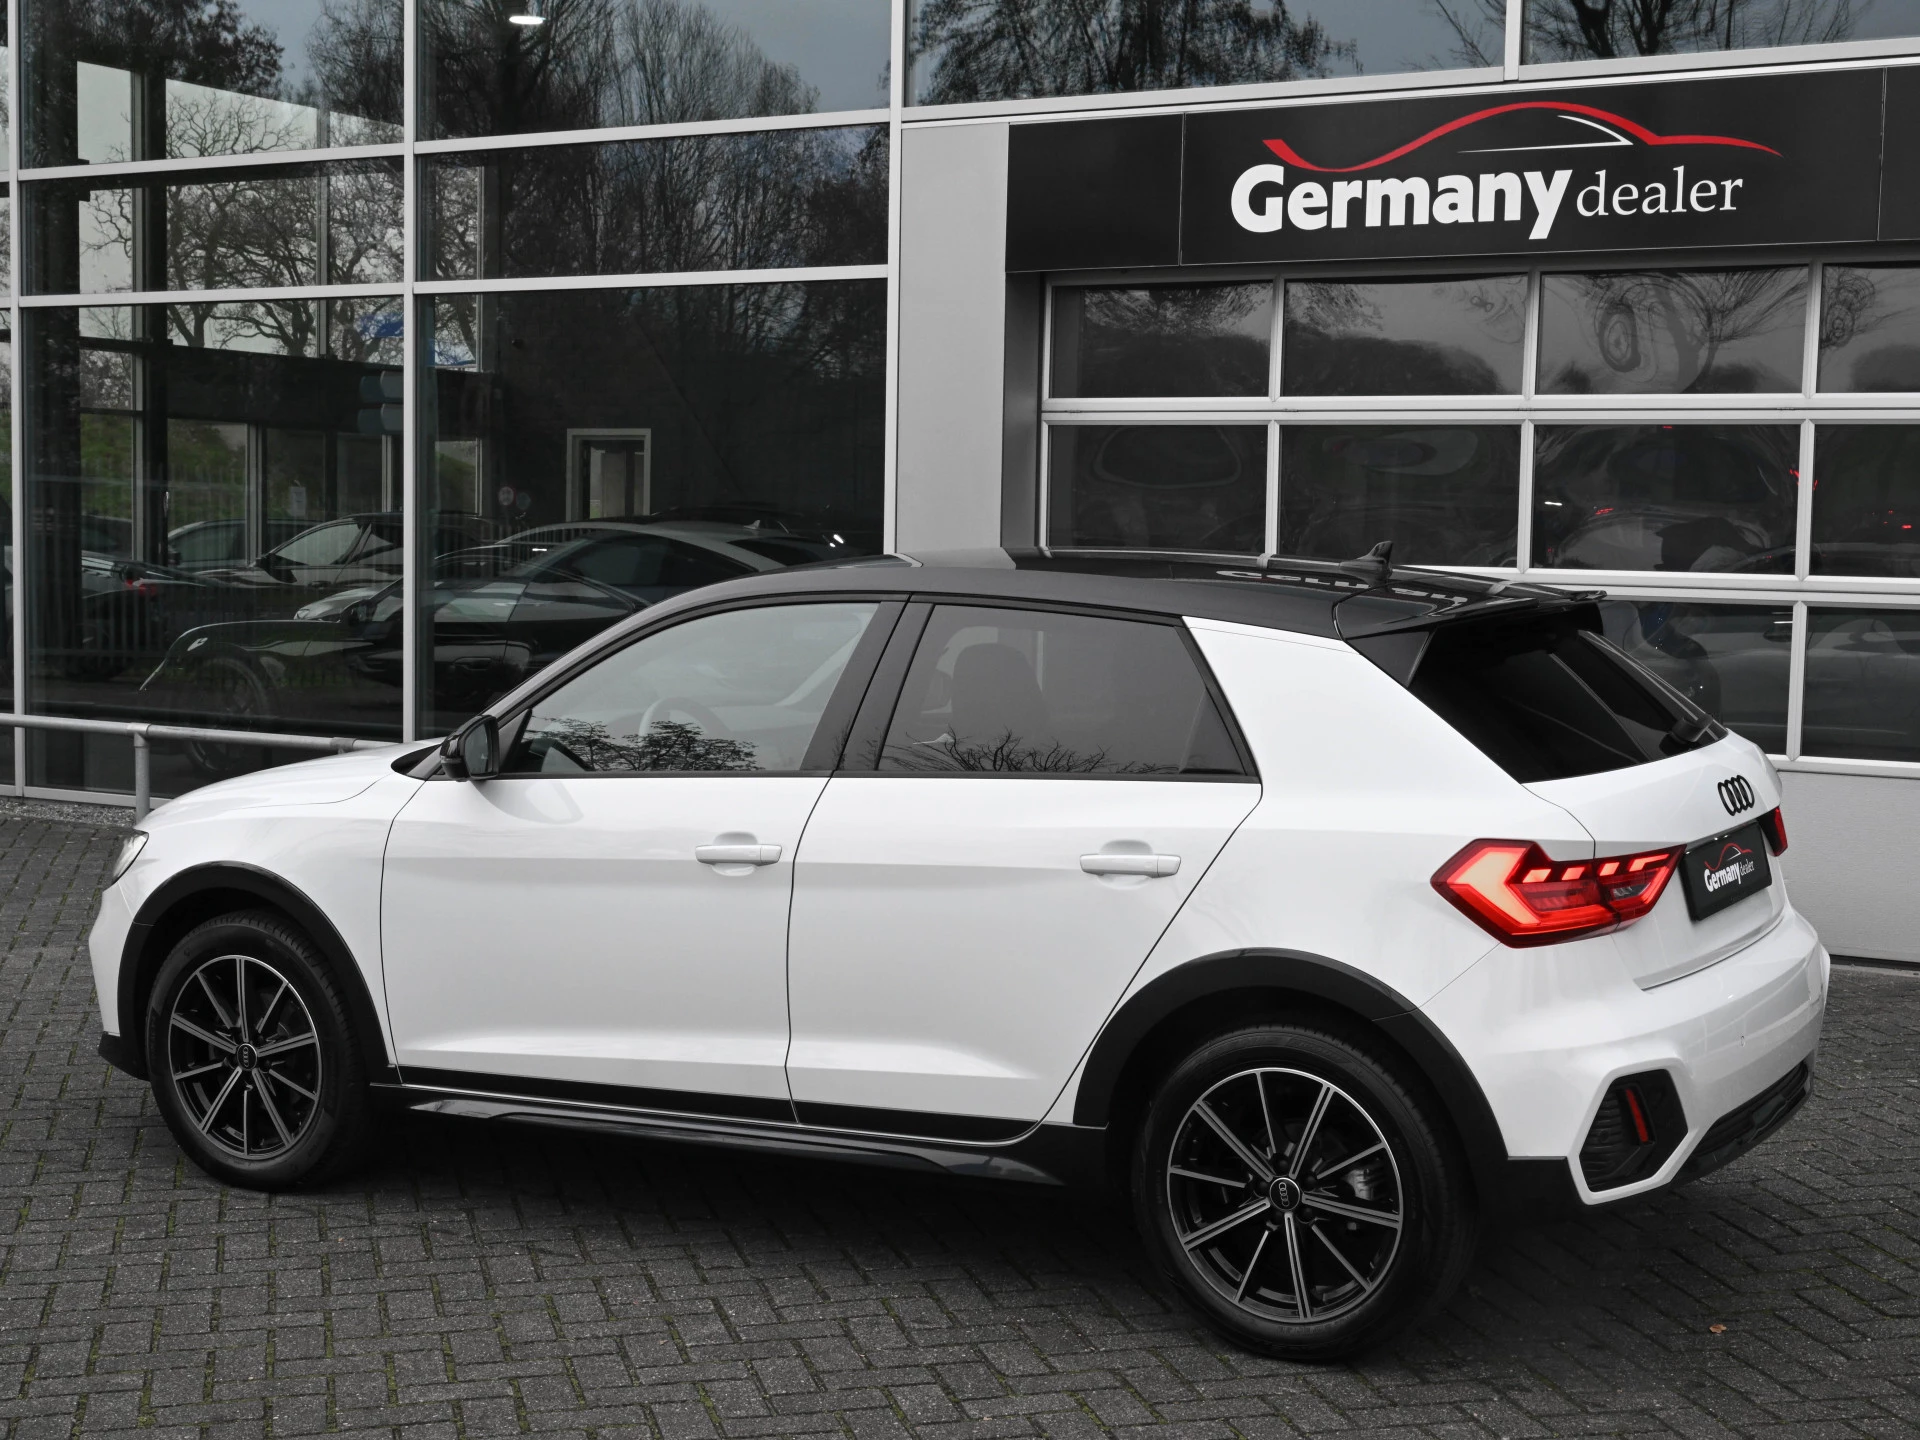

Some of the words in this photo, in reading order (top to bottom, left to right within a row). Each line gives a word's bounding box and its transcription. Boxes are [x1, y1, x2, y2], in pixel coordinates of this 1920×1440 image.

[1230, 164, 1573, 240] Germany
[1576, 166, 1743, 218] dealer
[1704, 861, 1741, 892] Germany
[1739, 859, 1754, 876] dealer
